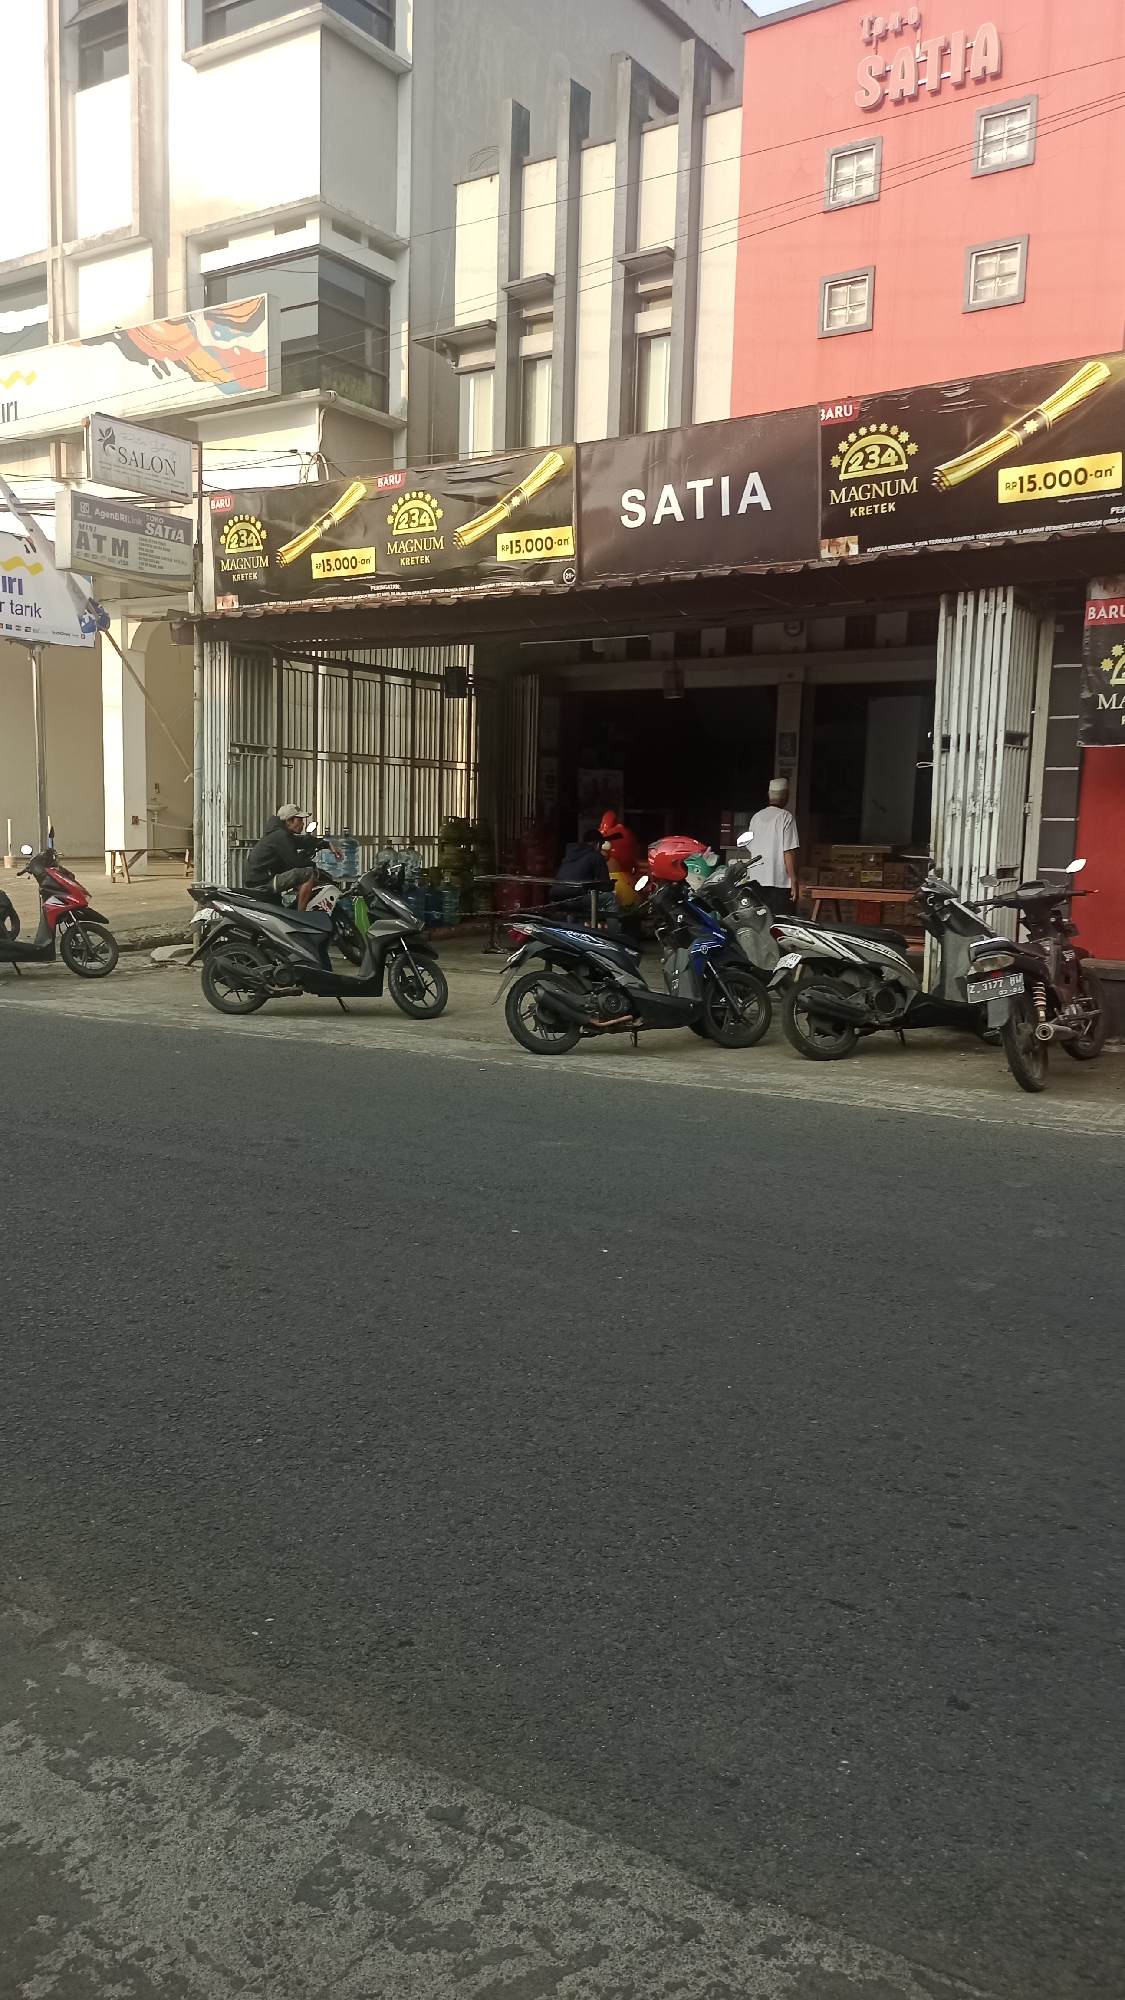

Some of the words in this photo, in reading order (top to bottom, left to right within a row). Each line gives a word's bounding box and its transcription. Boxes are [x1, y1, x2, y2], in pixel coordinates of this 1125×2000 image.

[855, 22, 1002, 109] SATIA
[821, 404, 853, 421] BARU
[118, 446, 176, 477] SALON
[848, 444, 898, 473] 234
[377, 473, 402, 488] BARU
[829, 476, 918, 505] MAGNUM
[210, 498, 231, 510] BARU
[620, 471, 772, 529] SATIA
[850, 502, 896, 517] KRETEK
[146, 514, 164, 524] TOKO
[398, 508, 431, 529] 234
[78, 523, 97, 532] MINI
[76, 530, 128, 558] ATM
[229, 529, 258, 549] 234
[386, 535, 444, 555] MAGNUM
[220, 555, 269, 572] MAGNUM
[400, 555, 430, 566] KRETEK
[232, 572, 258, 582] KRETEK
[982, 979, 1004, 991] 3177
